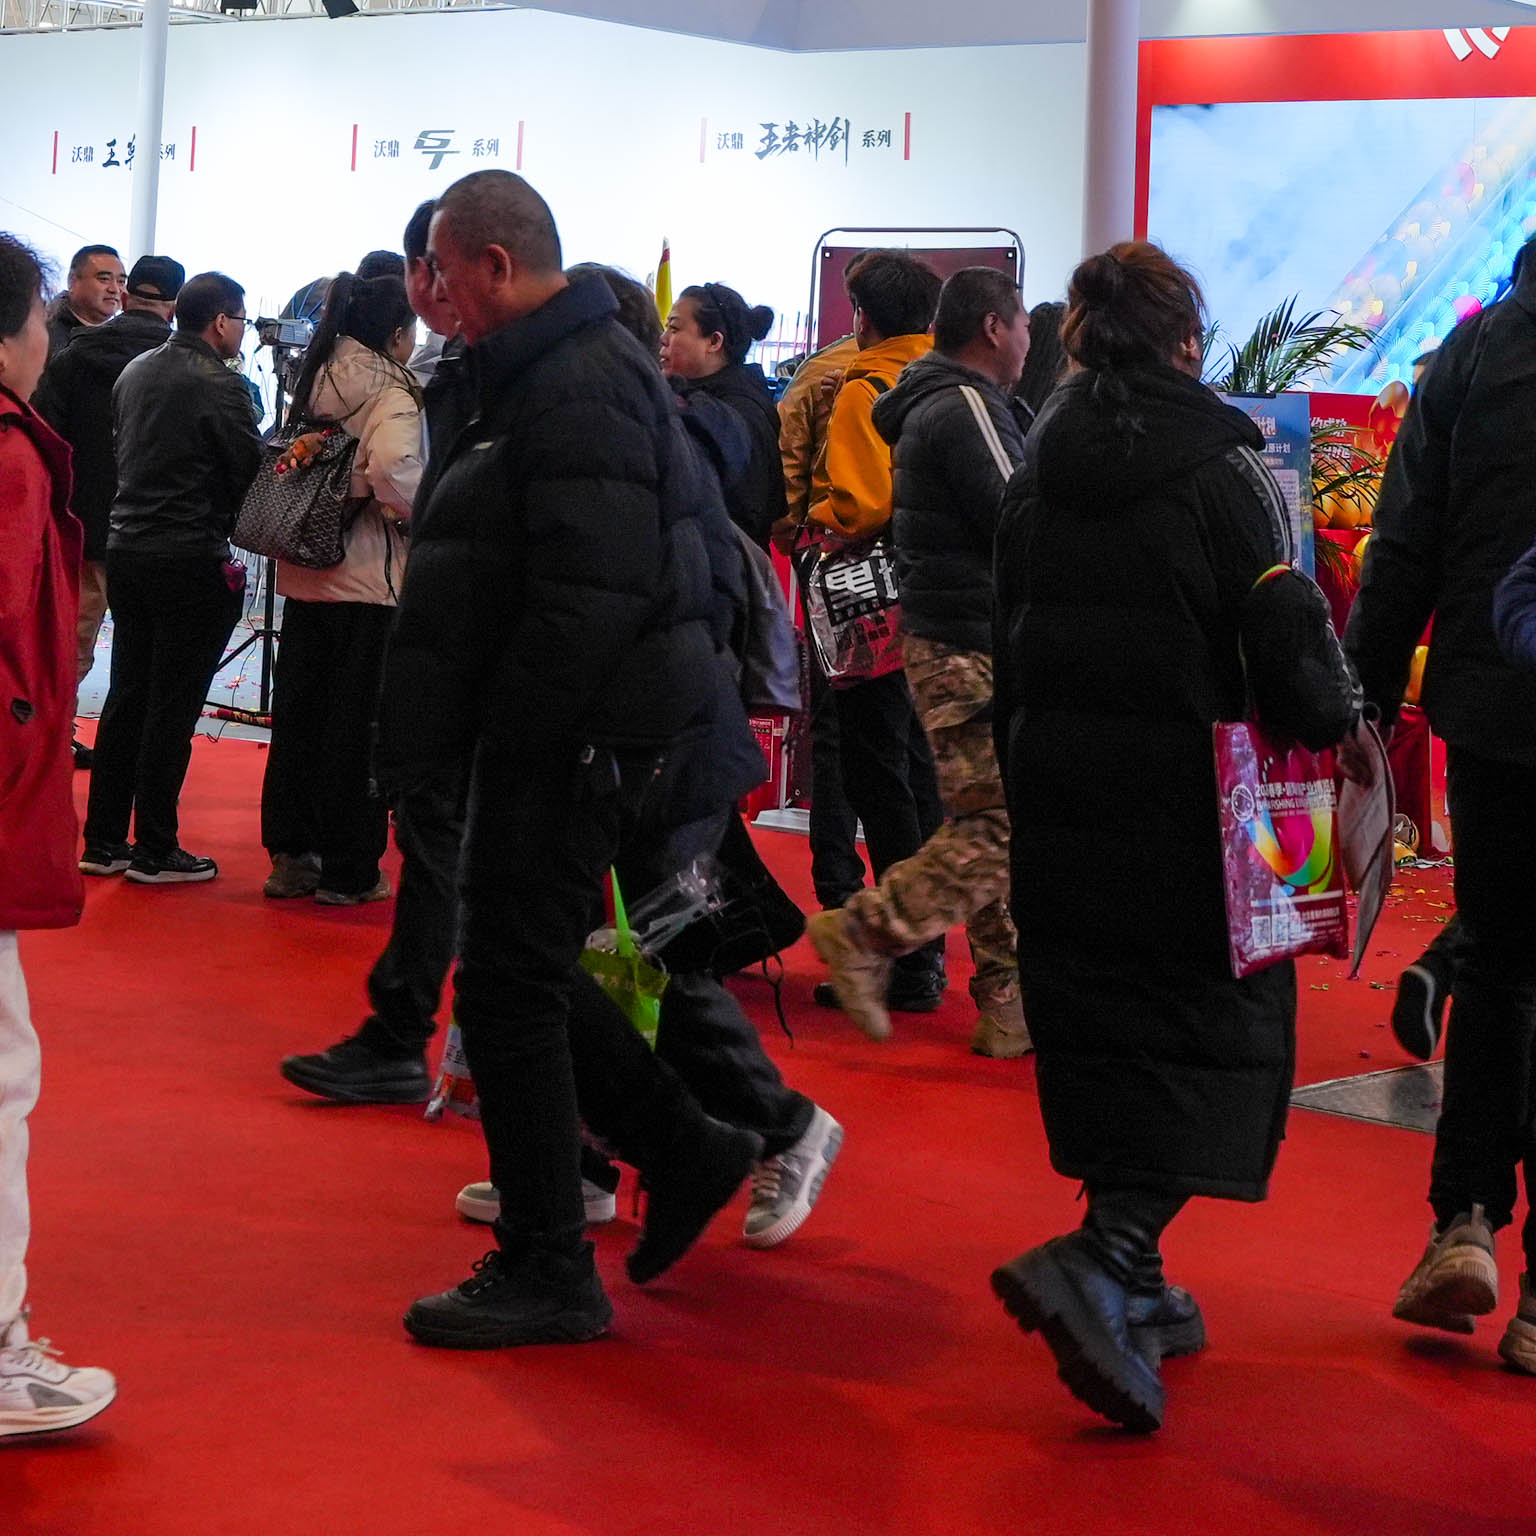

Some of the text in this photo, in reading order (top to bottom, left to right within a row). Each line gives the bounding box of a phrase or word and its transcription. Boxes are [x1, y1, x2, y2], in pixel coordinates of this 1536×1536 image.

[373, 139, 400, 158] 沃鼎
[472, 138, 499, 157] 系列
[716, 131, 744, 151] 沃鼎
[861, 129, 891, 148] 系列
[71, 145, 94, 163] 沃鼎
